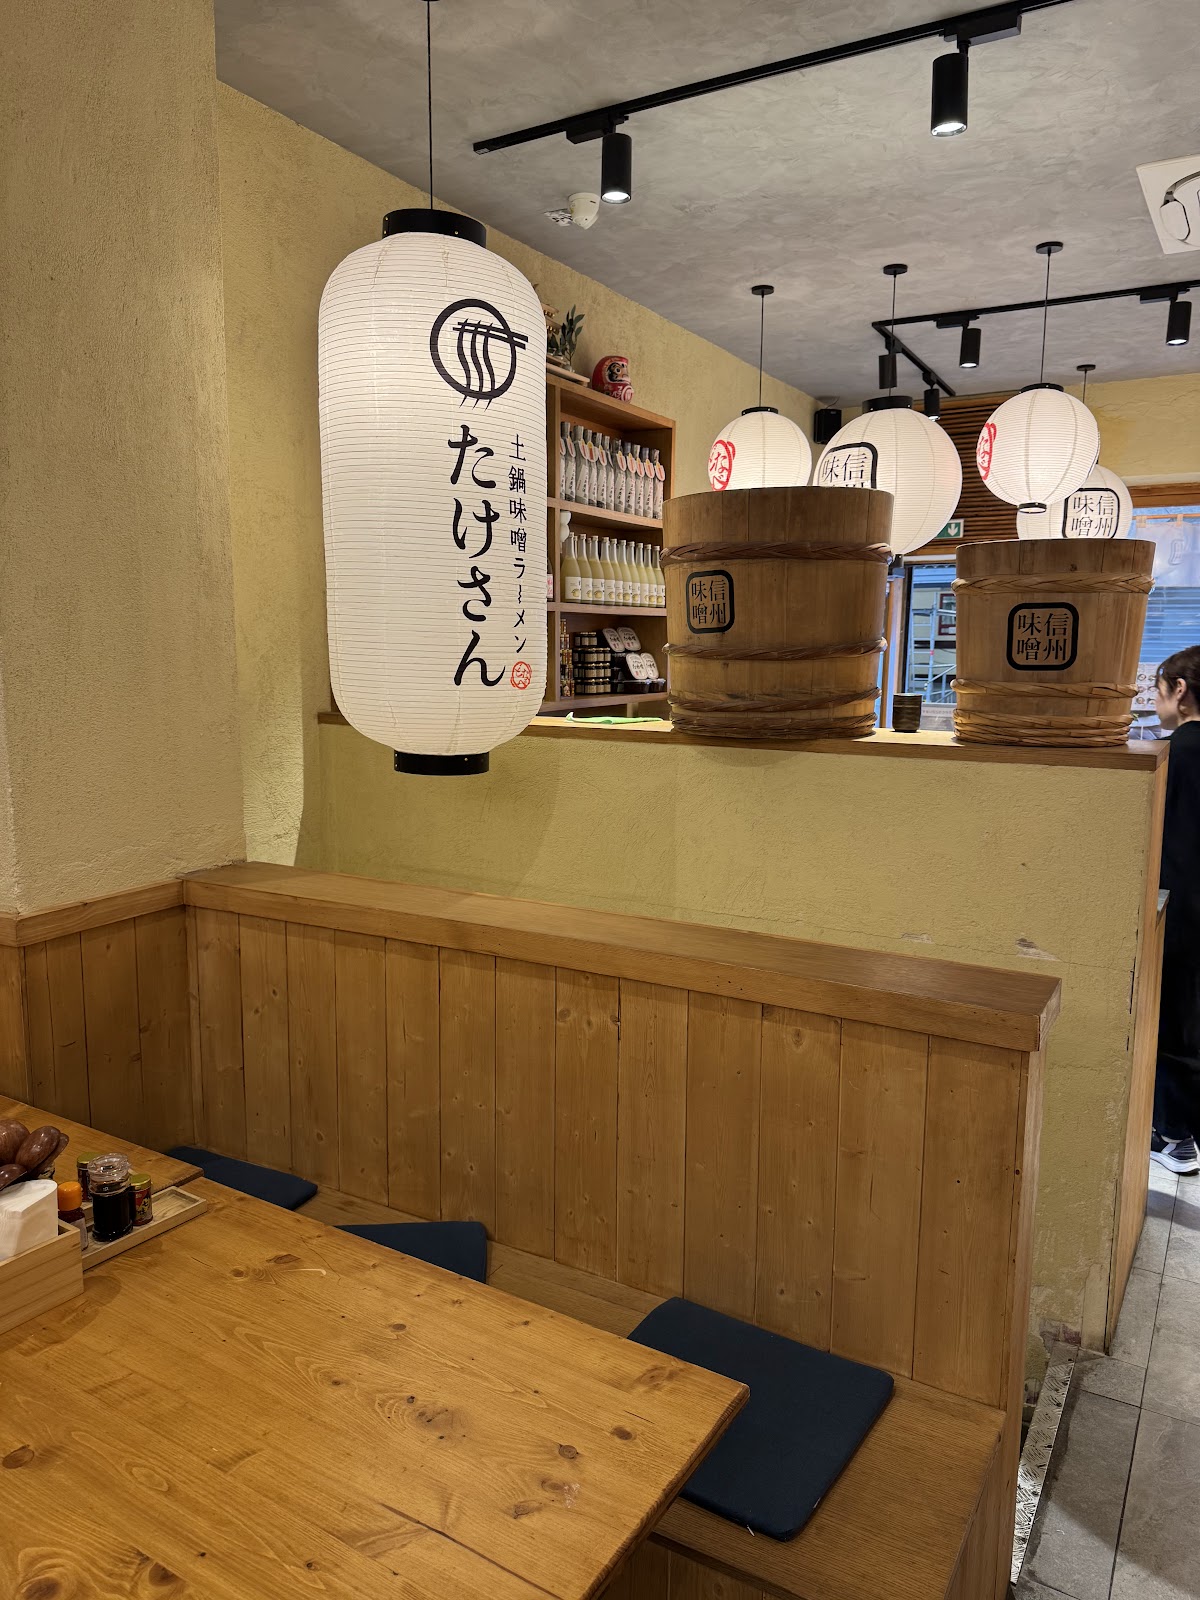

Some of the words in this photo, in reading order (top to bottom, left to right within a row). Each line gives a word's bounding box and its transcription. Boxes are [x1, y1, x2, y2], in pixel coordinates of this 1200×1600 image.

[841, 452, 868, 488] 信
[1094, 495, 1115, 537] 信州
[447, 424, 506, 687] たけさん
[507, 433, 528, 654] 土鍋味噌ラーメン
[708, 579, 726, 624] 信州
[1016, 612, 1042, 661] 味噌
[1042, 612, 1069, 661] 信州
